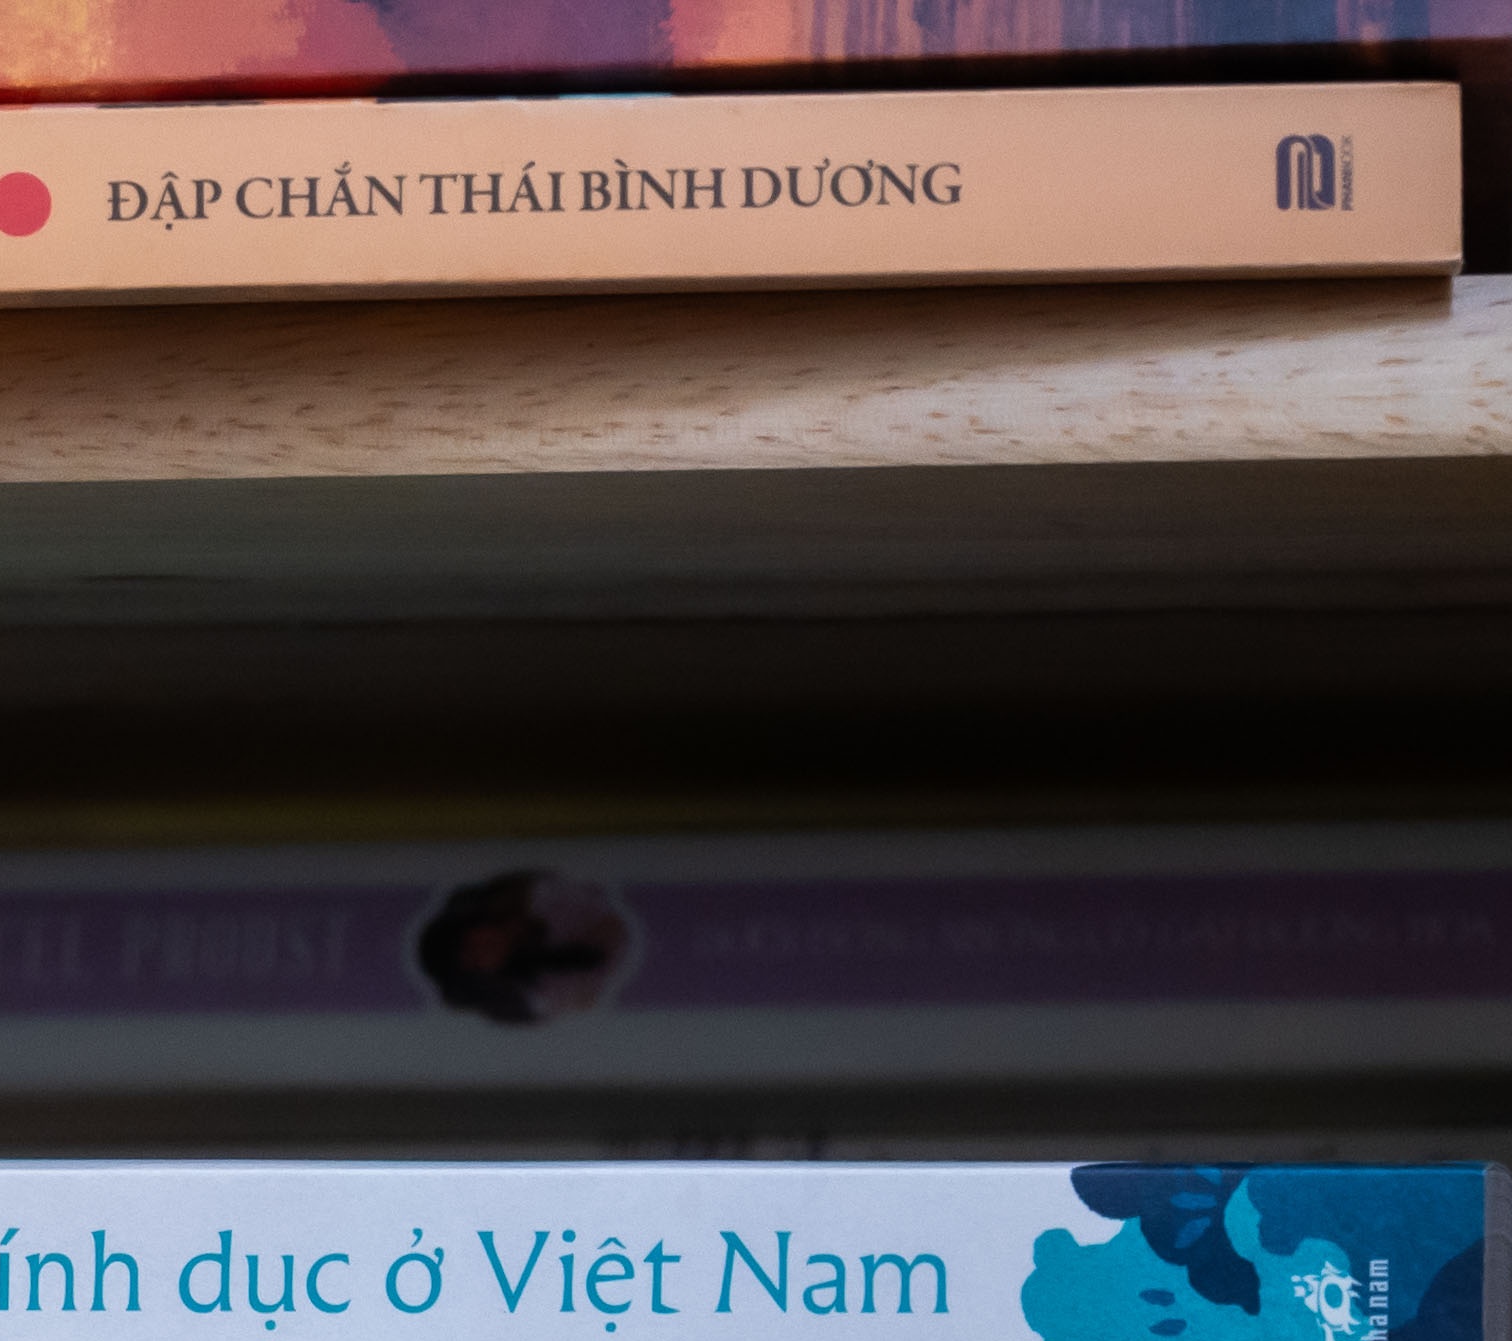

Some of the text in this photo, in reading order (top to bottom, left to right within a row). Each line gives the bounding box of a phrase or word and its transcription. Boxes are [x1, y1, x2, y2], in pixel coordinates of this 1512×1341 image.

[106, 157, 964, 232] ĐẬP CHẮN THÁI BÌNH DƯƠNG
[176, 1229, 350, 1333] dục
[384, 1226, 450, 1317] ở
[479, 1229, 682, 1332] Việt
[713, 1229, 951, 1317] Nam
